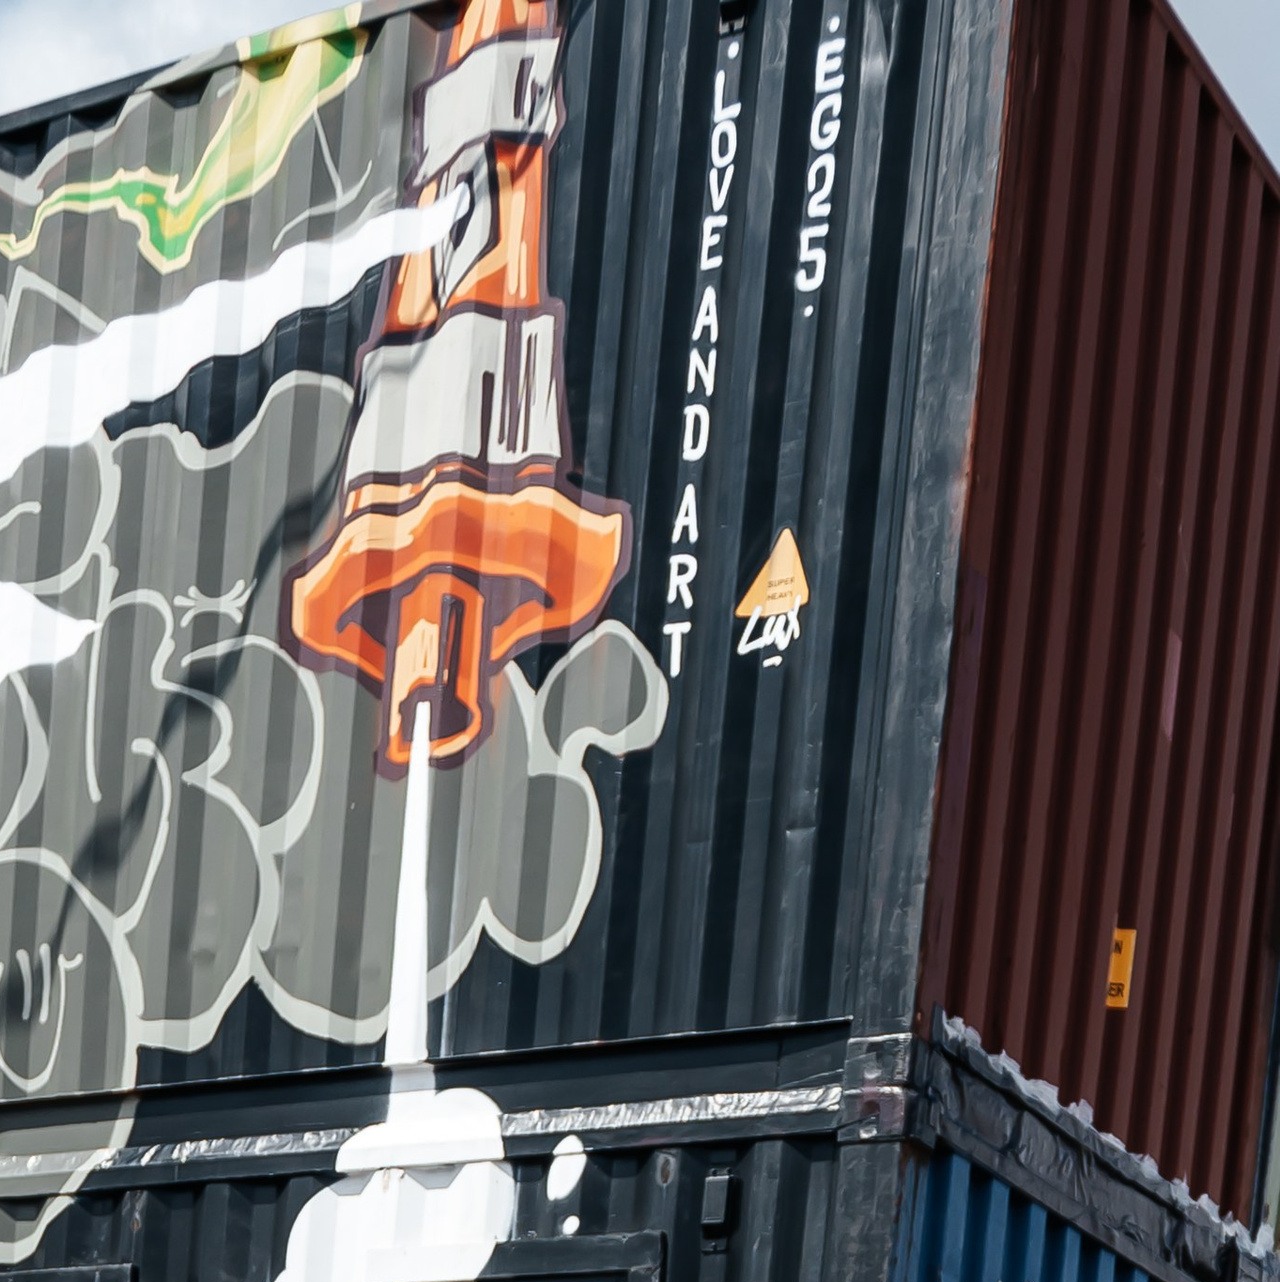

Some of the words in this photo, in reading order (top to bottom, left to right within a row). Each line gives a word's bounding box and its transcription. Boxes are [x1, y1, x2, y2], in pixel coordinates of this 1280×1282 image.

[701, 69, 741, 271] LOVE
[682, 285, 719, 461] AND
[663, 483, 699, 678] ART
